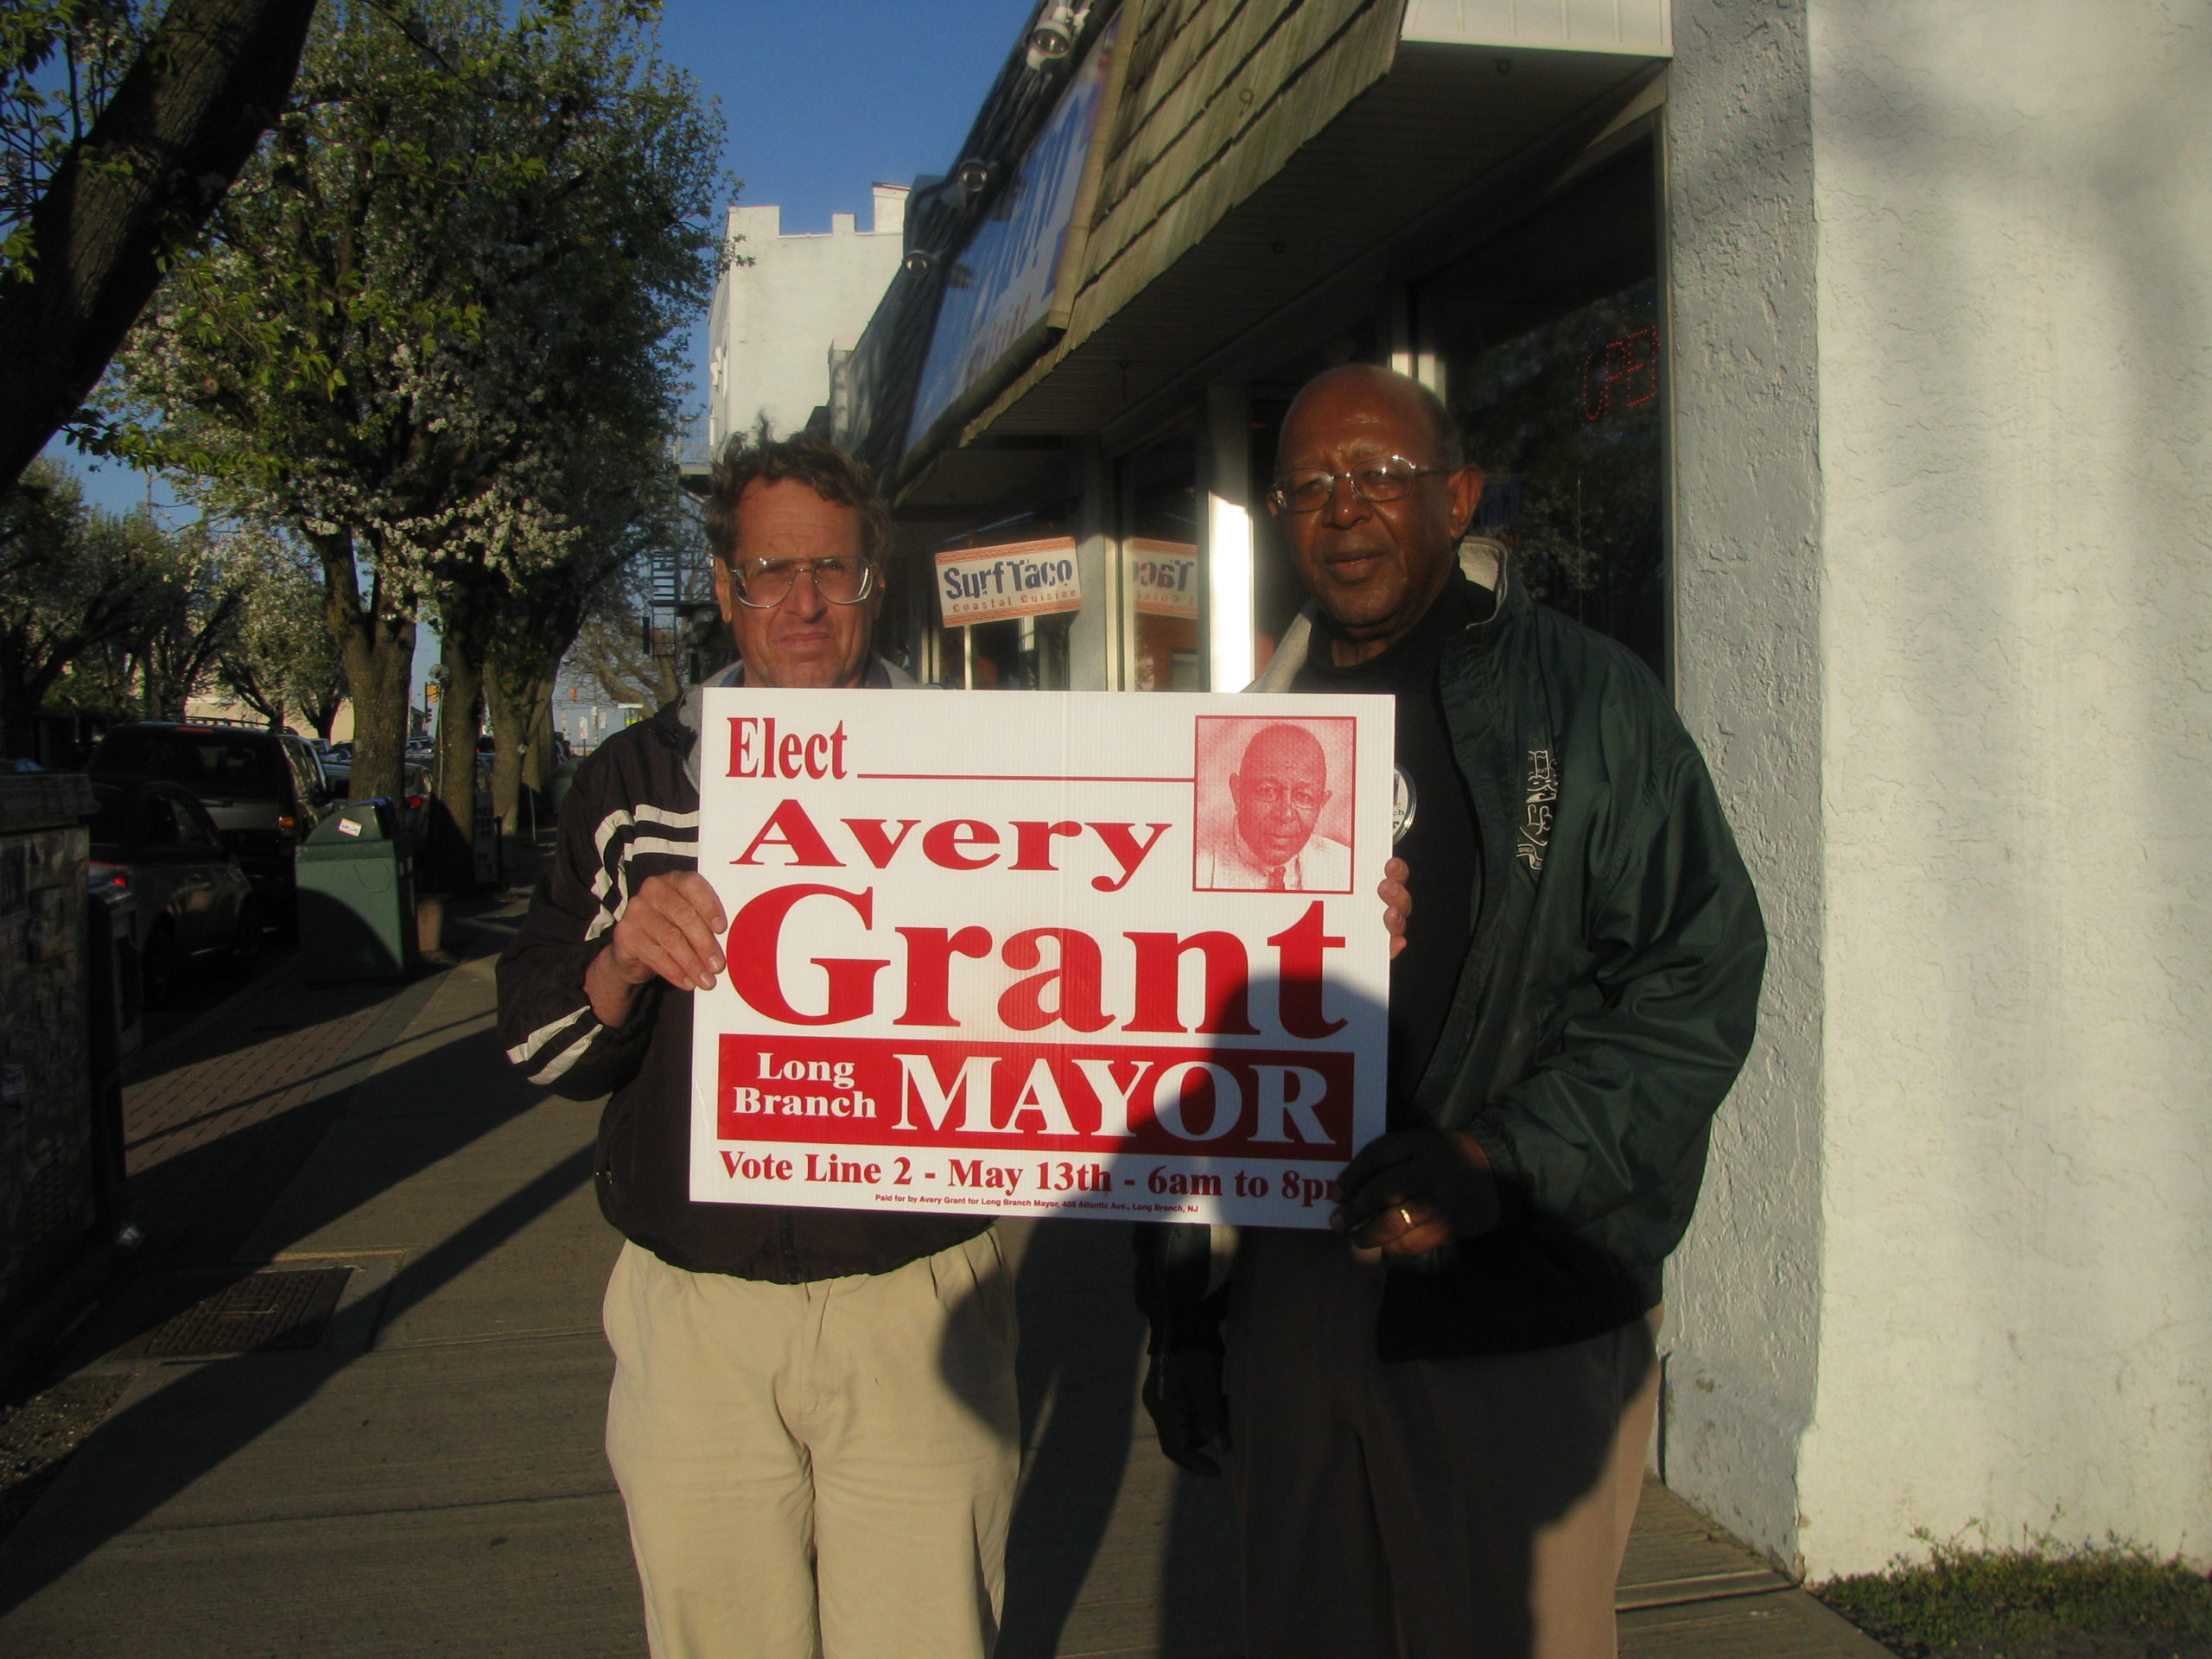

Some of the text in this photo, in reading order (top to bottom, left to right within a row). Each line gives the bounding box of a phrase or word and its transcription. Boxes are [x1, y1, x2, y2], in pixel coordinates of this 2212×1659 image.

[944, 559, 1073, 600] Surf Taco
[953, 589, 1077, 613] Coastal Cuisine
[726, 717, 848, 779] Elect
[729, 798, 1173, 893] Avery
[726, 883, 1348, 1039] Grant
[757, 1052, 855, 1088] Long
[732, 1087, 877, 1119] Branch
[891, 1053, 1337, 1145] MAYOR
[718, 1150, 793, 1181] Vote
[804, 1154, 881, 1185] Line
[893, 1156, 912, 1185] 2
[949, 1159, 1023, 1197] May
[1036, 1161, 1112, 1192] 13th
[1147, 1166, 1223, 1198] 6am
[1234, 1171, 1269, 1198] to
[907, 1195, 918, 1204] by
[919, 1196, 942, 1205] Avery
[982, 1198, 1001, 1206] Long
[1033, 1200, 1060, 1209] Mayor,
[1132, 1203, 1153, 1211] Long
[1154, 1204, 1185, 1213] Branch,
[1187, 1205, 1199, 1213] NJ
